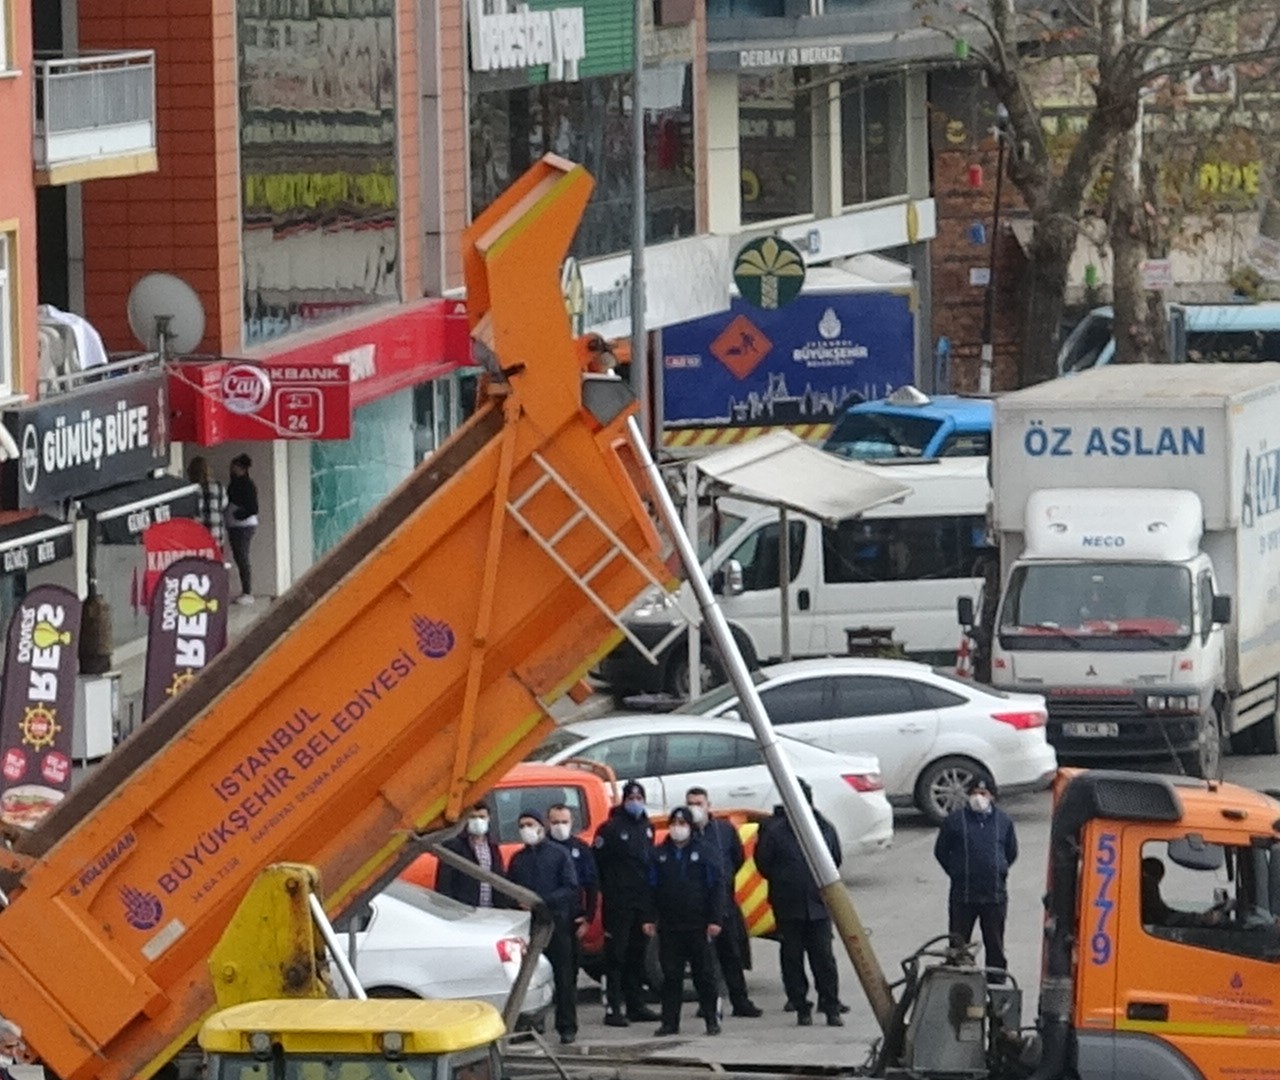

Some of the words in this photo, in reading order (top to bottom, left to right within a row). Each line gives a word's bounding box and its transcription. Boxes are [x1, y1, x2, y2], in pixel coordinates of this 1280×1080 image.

[266, 367, 341, 380] KBANK
[43, 414, 104, 473] GÜMÜŞ
[104, 400, 149, 457] BÜFE
[287, 415, 309, 431] 24
[1023, 420, 1073, 457] ÖZ
[1084, 426, 1206, 457] ASLAN
[1082, 536, 1125, 547] NECO
[157, 766, 296, 895] BÜYÜKŞEHİR
[293, 648, 418, 771] BELEDİYESİ
[215, 706, 322, 803] İSTANBUL
[78, 830, 138, 888] KOLUMAN
[1091, 833, 1118, 966] 5779
